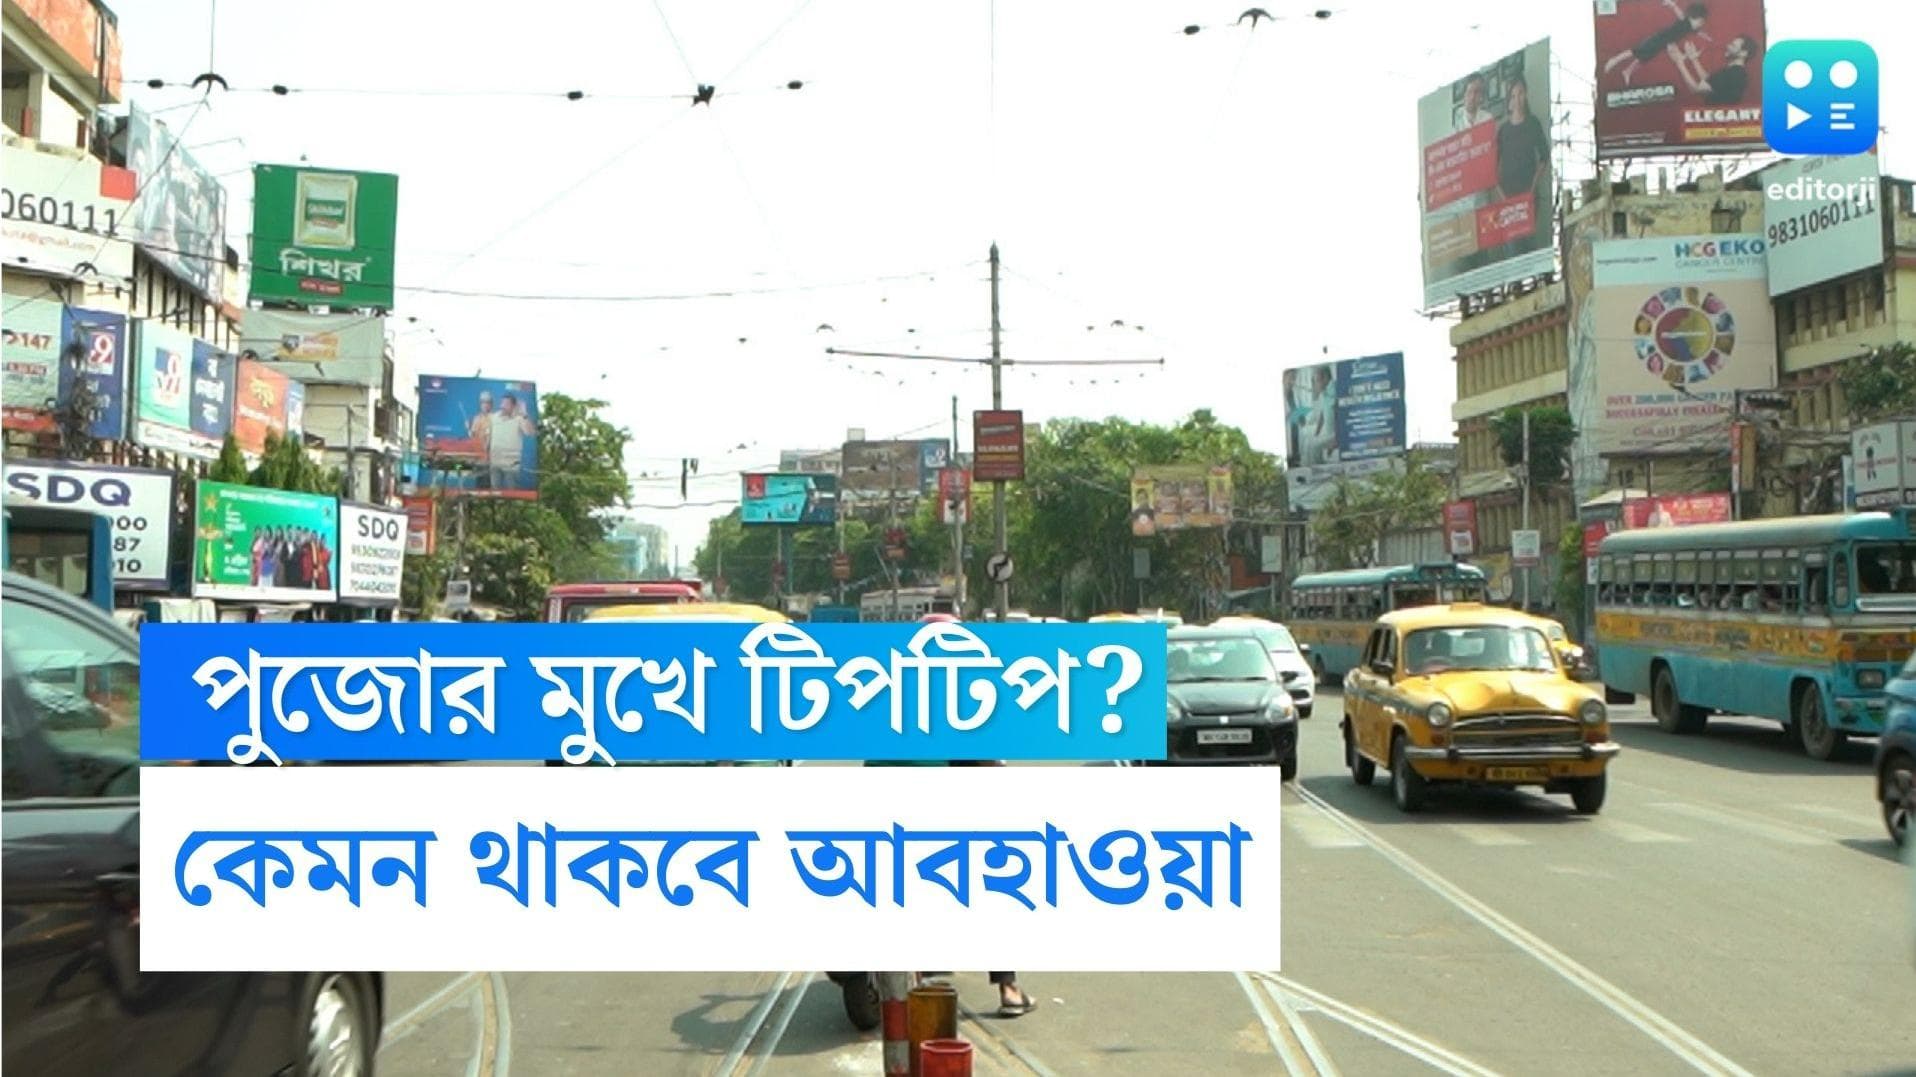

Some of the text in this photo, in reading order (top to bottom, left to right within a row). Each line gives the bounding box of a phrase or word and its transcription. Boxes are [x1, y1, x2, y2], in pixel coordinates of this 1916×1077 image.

[1767, 190, 1875, 248] 9831060111
[278, 247, 366, 282] শিখর
[1675, 239, 1765, 258] HCG EKO
[7, 471, 132, 506] SDQ
[357, 513, 399, 541] SDQ
